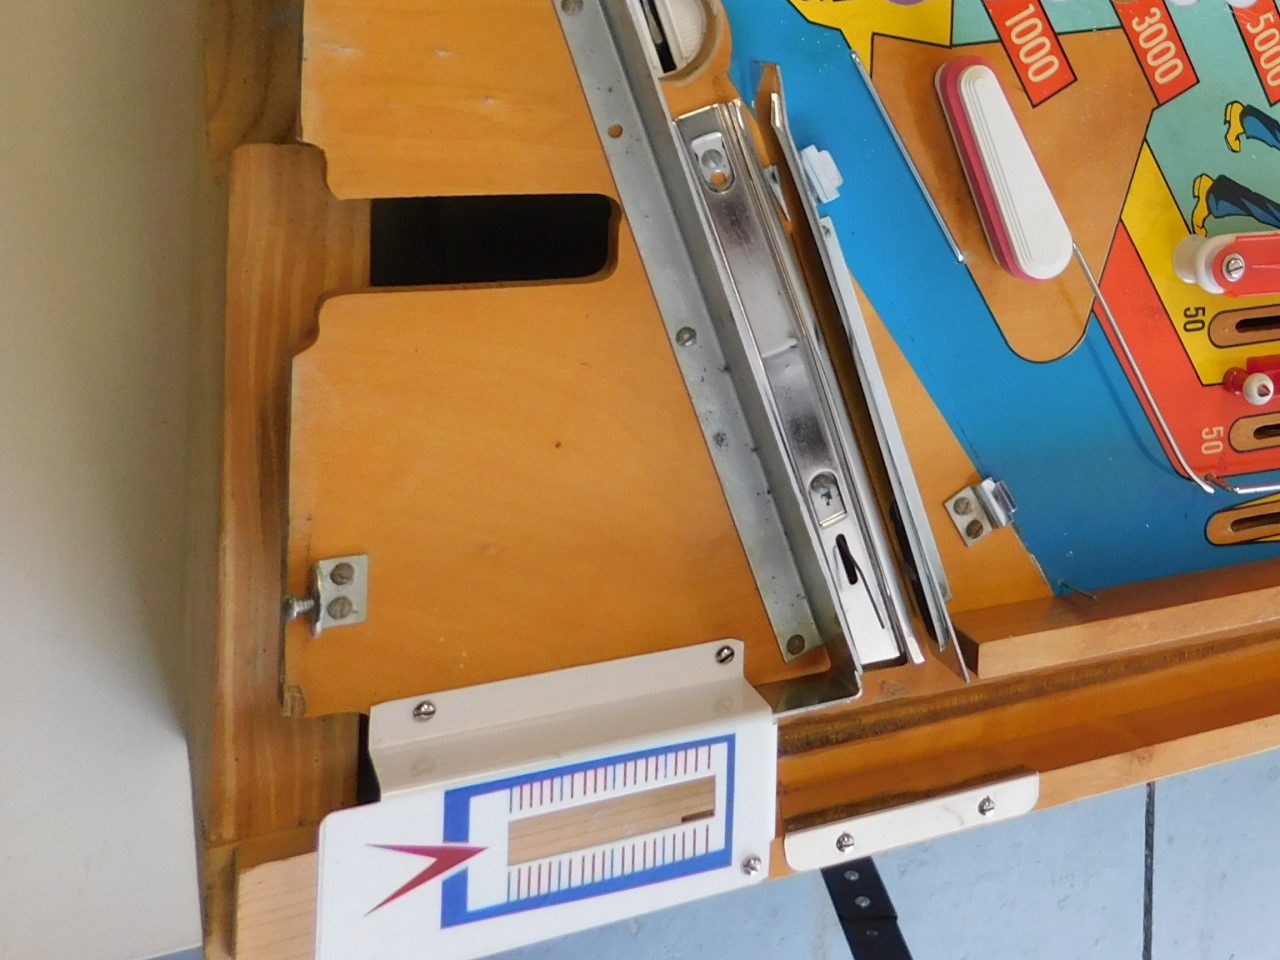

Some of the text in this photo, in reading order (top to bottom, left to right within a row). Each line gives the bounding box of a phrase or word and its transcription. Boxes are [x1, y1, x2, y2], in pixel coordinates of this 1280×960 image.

[1005, 4, 1059, 83] 1000
[1131, 7, 1184, 86] 3000
[1183, 306, 1206, 332] 50
[1201, 426, 1224, 455] 50
